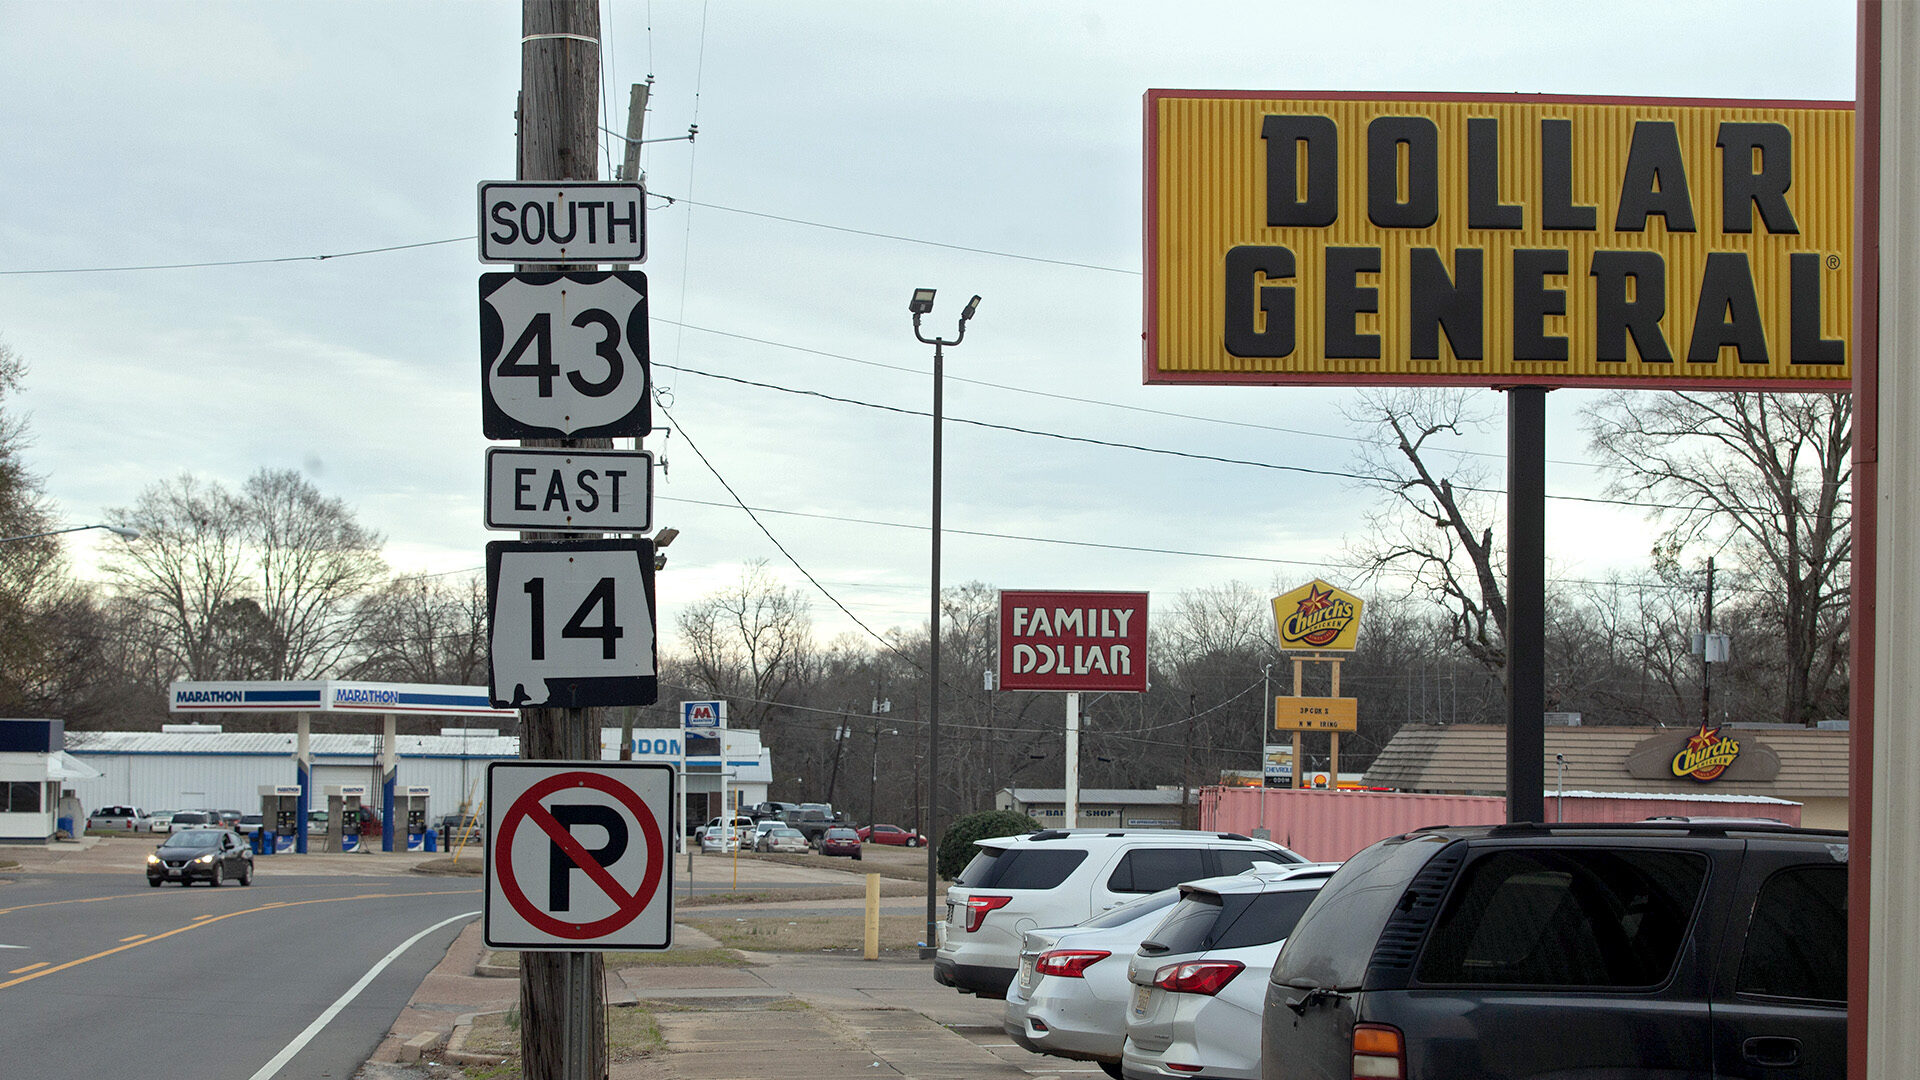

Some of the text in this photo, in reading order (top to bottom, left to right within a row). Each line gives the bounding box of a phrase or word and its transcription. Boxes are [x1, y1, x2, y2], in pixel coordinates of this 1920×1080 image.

[1260, 114, 1800, 235] DOLLAR
[490, 200, 637, 245] SOUTH
[1224, 245, 1845, 366] GENERAL
[497, 308, 625, 398] 43
[514, 468, 627, 513] EAST
[523, 577, 624, 661] 14
[1012, 606, 1135, 638] FAMILY
[1282, 599, 1353, 641] Church's
[1012, 643, 1131, 676] DOLLAR
[176, 691, 242, 702] MARATHON
[336, 689, 399, 703] MARATHON
[632, 738, 682, 755] DOM
[1671, 736, 1740, 777] Church's
[1045, 809, 1066, 817] BAI
[1086, 809, 1114, 817] SHOP
